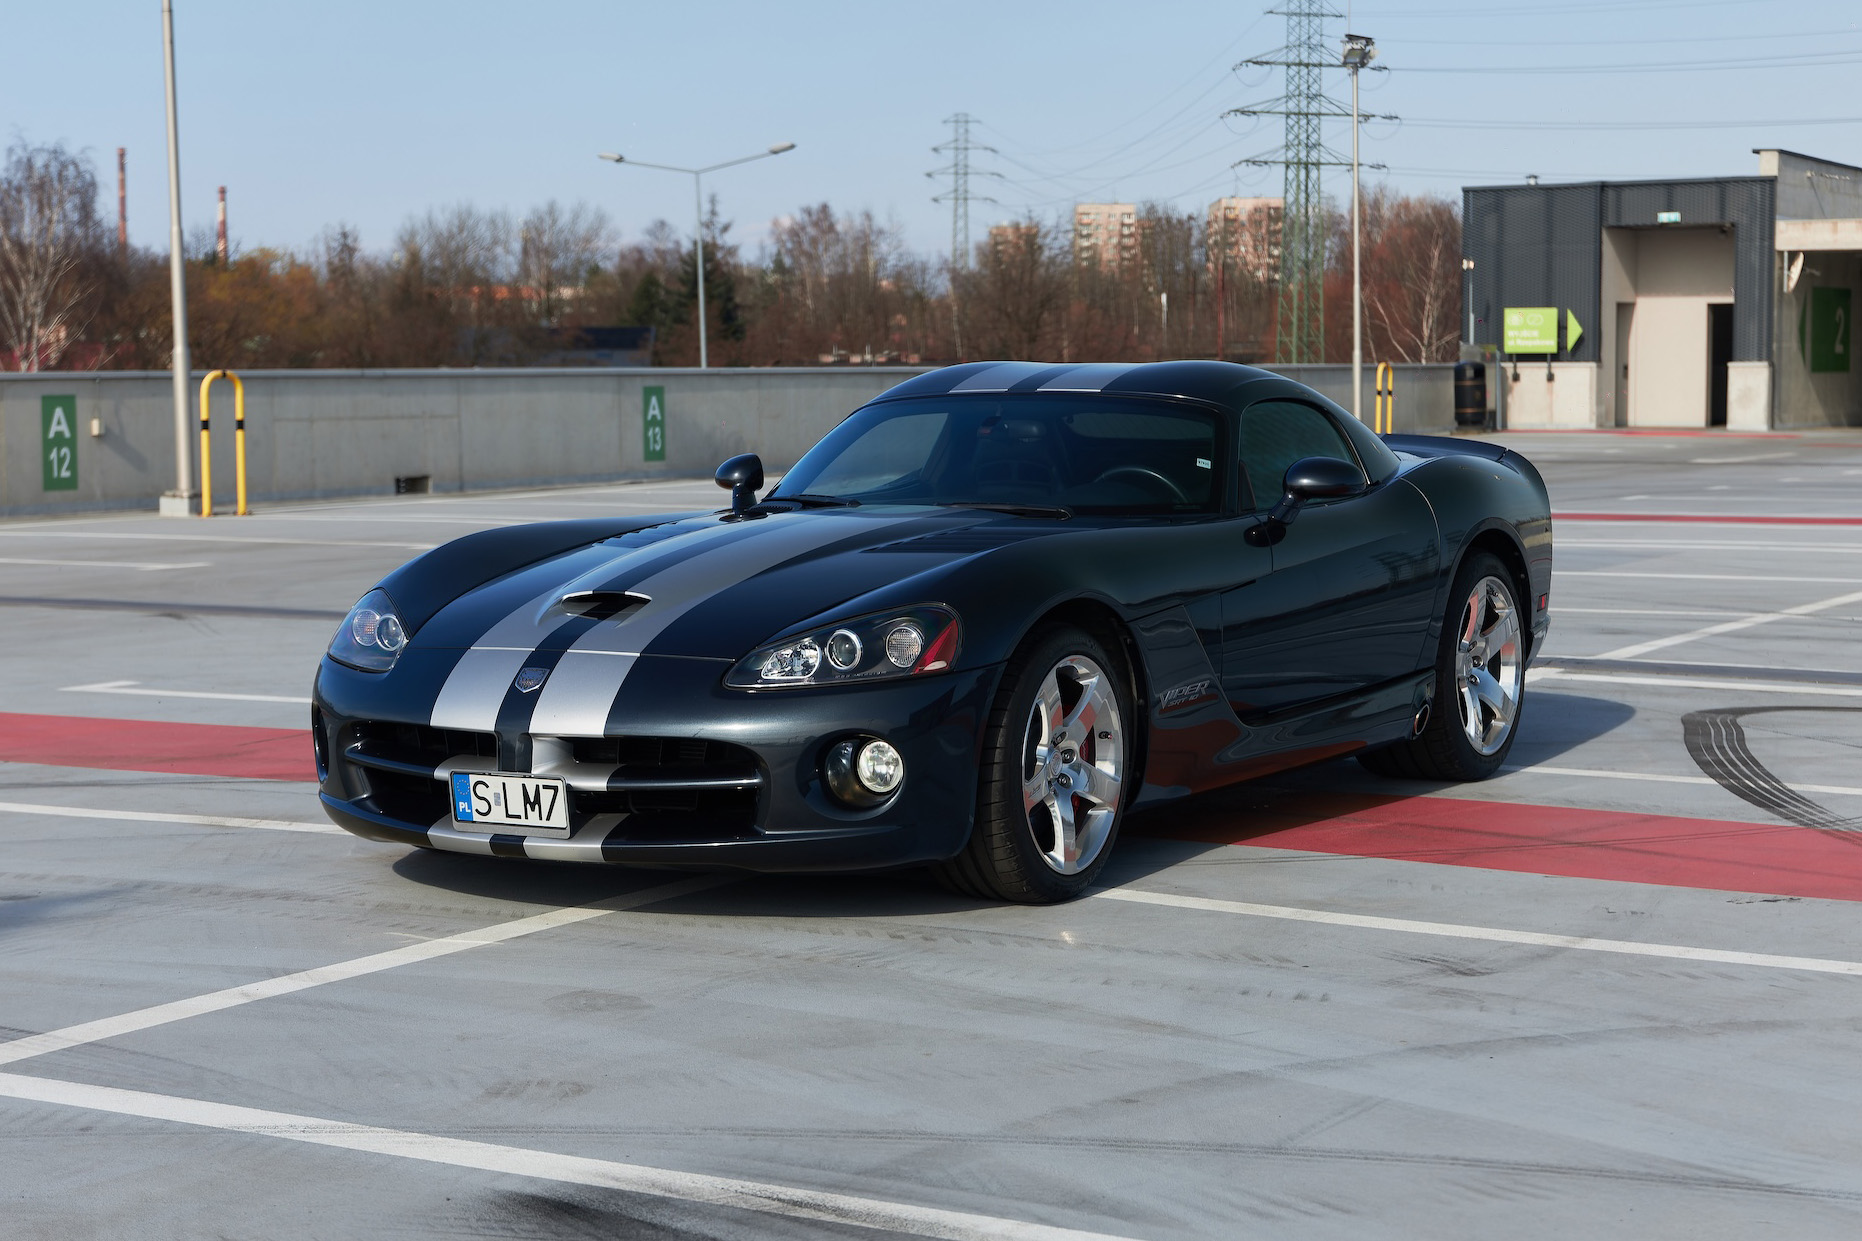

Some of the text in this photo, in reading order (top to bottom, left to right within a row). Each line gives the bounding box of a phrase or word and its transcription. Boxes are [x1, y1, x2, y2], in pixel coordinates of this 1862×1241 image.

[1834, 305, 1845, 354] 2
[47, 405, 71, 439] A
[647, 394, 662, 421] A
[648, 426, 662, 452] 13
[49, 446, 71, 479] 12
[1159, 680, 1210, 709] VIPER
[458, 801, 471, 813] PL
[502, 781, 559, 822] LM7
